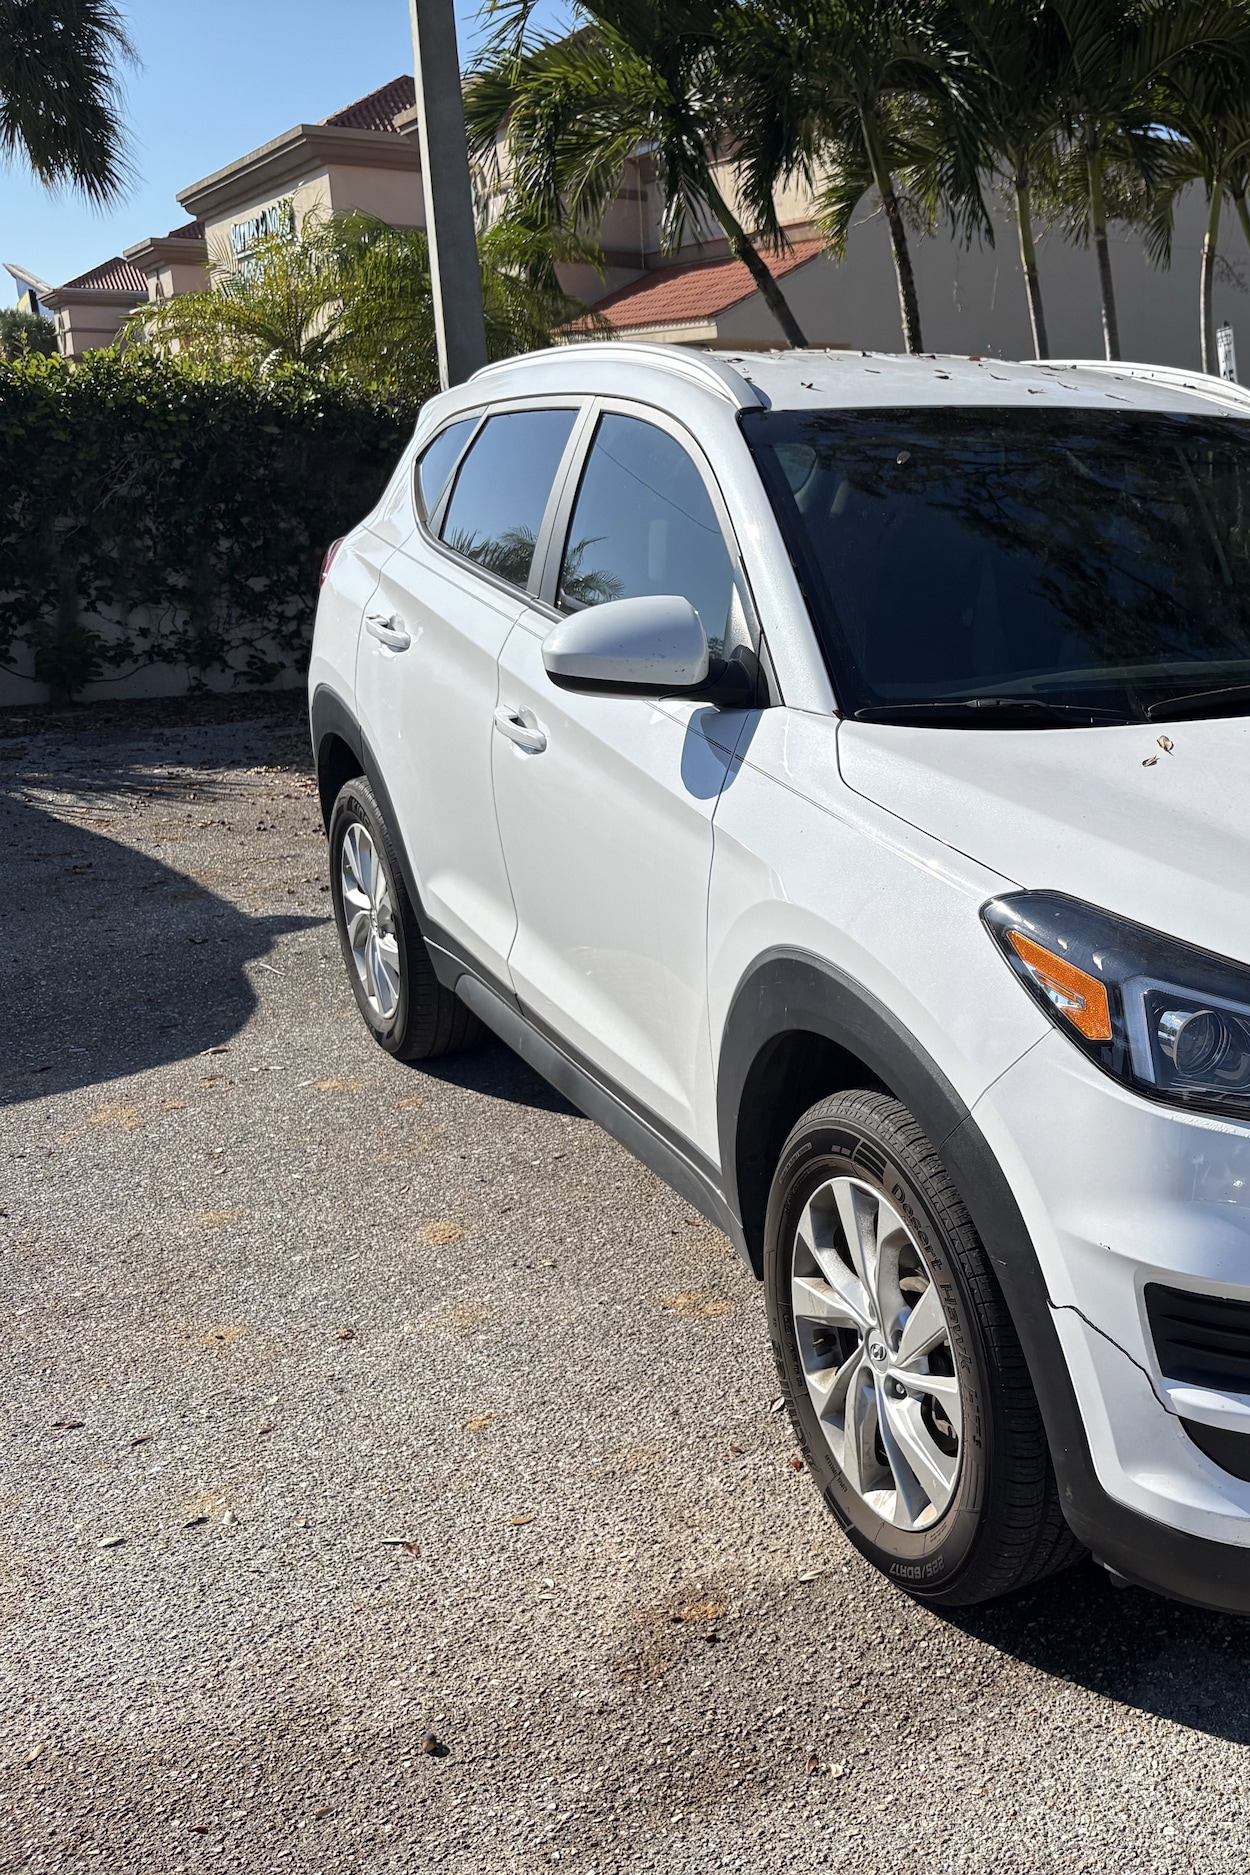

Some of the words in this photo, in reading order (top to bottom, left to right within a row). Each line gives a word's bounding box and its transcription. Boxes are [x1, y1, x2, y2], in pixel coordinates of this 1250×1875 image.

[892, 1183, 943, 1271] Desert
[940, 1283, 972, 1375] Hawk
[889, 1554, 945, 1579] 225/60R17
